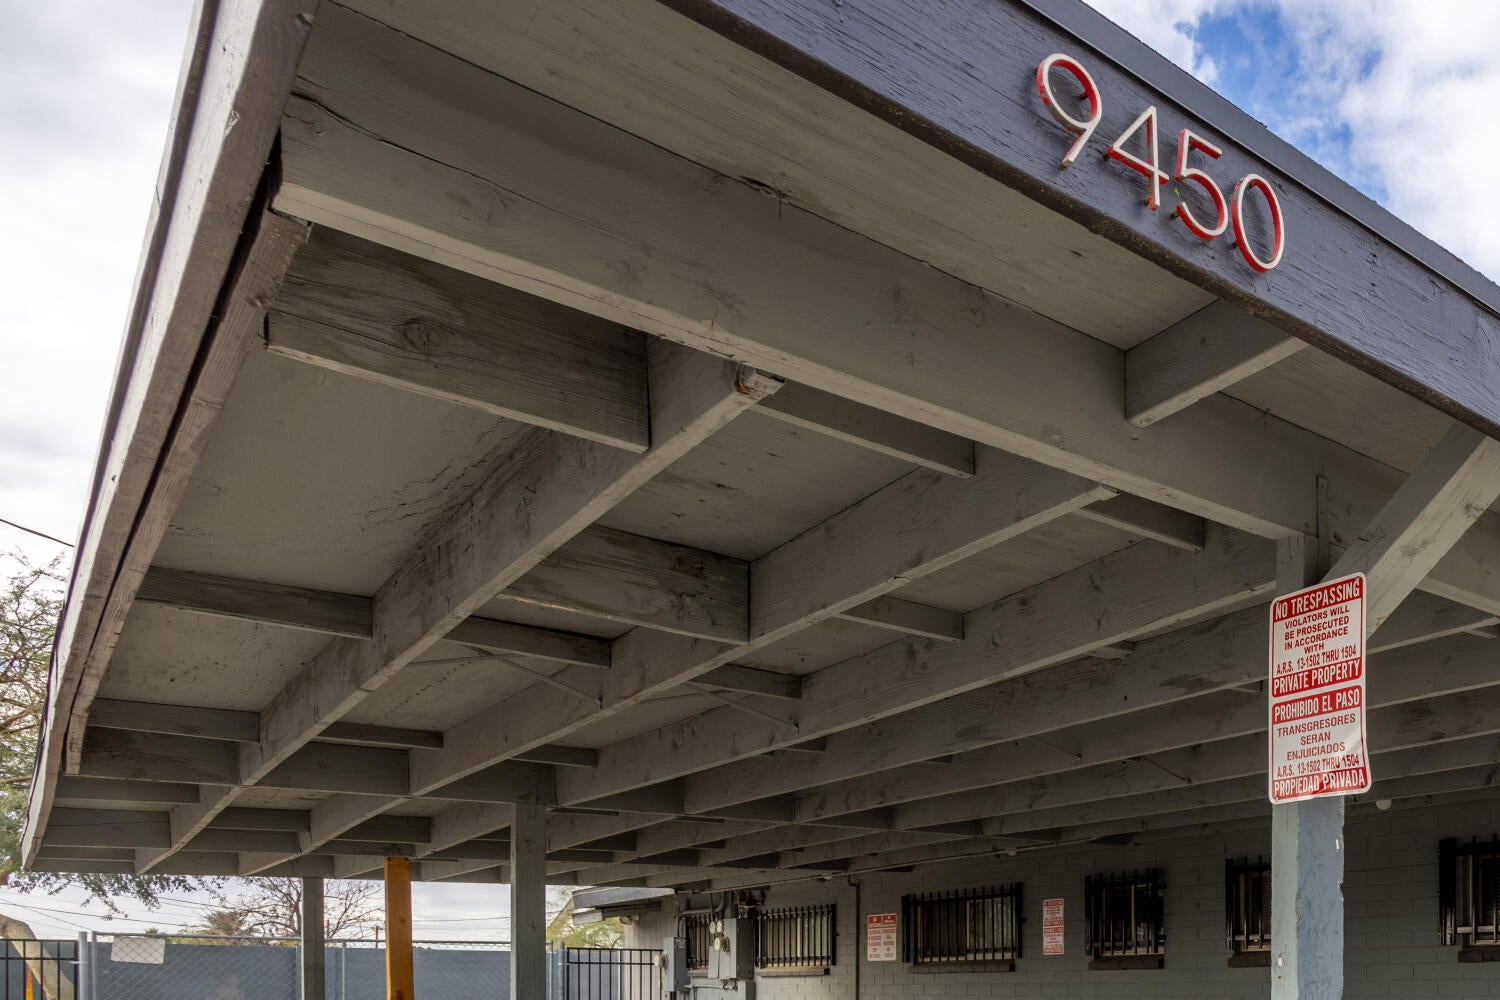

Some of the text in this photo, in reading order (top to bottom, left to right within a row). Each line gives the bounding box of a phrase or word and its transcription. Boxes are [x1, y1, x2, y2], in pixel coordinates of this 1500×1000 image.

[1036, 53, 1284, 273] 9450
[1275, 581, 1360, 620] NO TRESPASSING
[1284, 616, 1350, 640] BE PROSECUTED
[1285, 605, 1350, 629] VIOLATORS WILL
[1284, 627, 1349, 651] IN ACCORDANCE
[1304, 643, 1324, 654] WITH
[1277, 644, 1357, 675] A.R.S. 13-1502 THRU 1504
[1274, 659, 1360, 695] PRIVATE PROPERTY
[1274, 688, 1360, 722] PROHIBIDO EL PASO
[1277, 713, 1356, 737] TRANSGRESORES
[1300, 731, 1331, 745] SERAN
[1287, 742, 1345, 760] ENJUICIADOS
[1277, 753, 1360, 777] A.R.S. 13-1502 THRU 1504
[1274, 769, 1366, 797] PROPIEDAD PRIVADA
